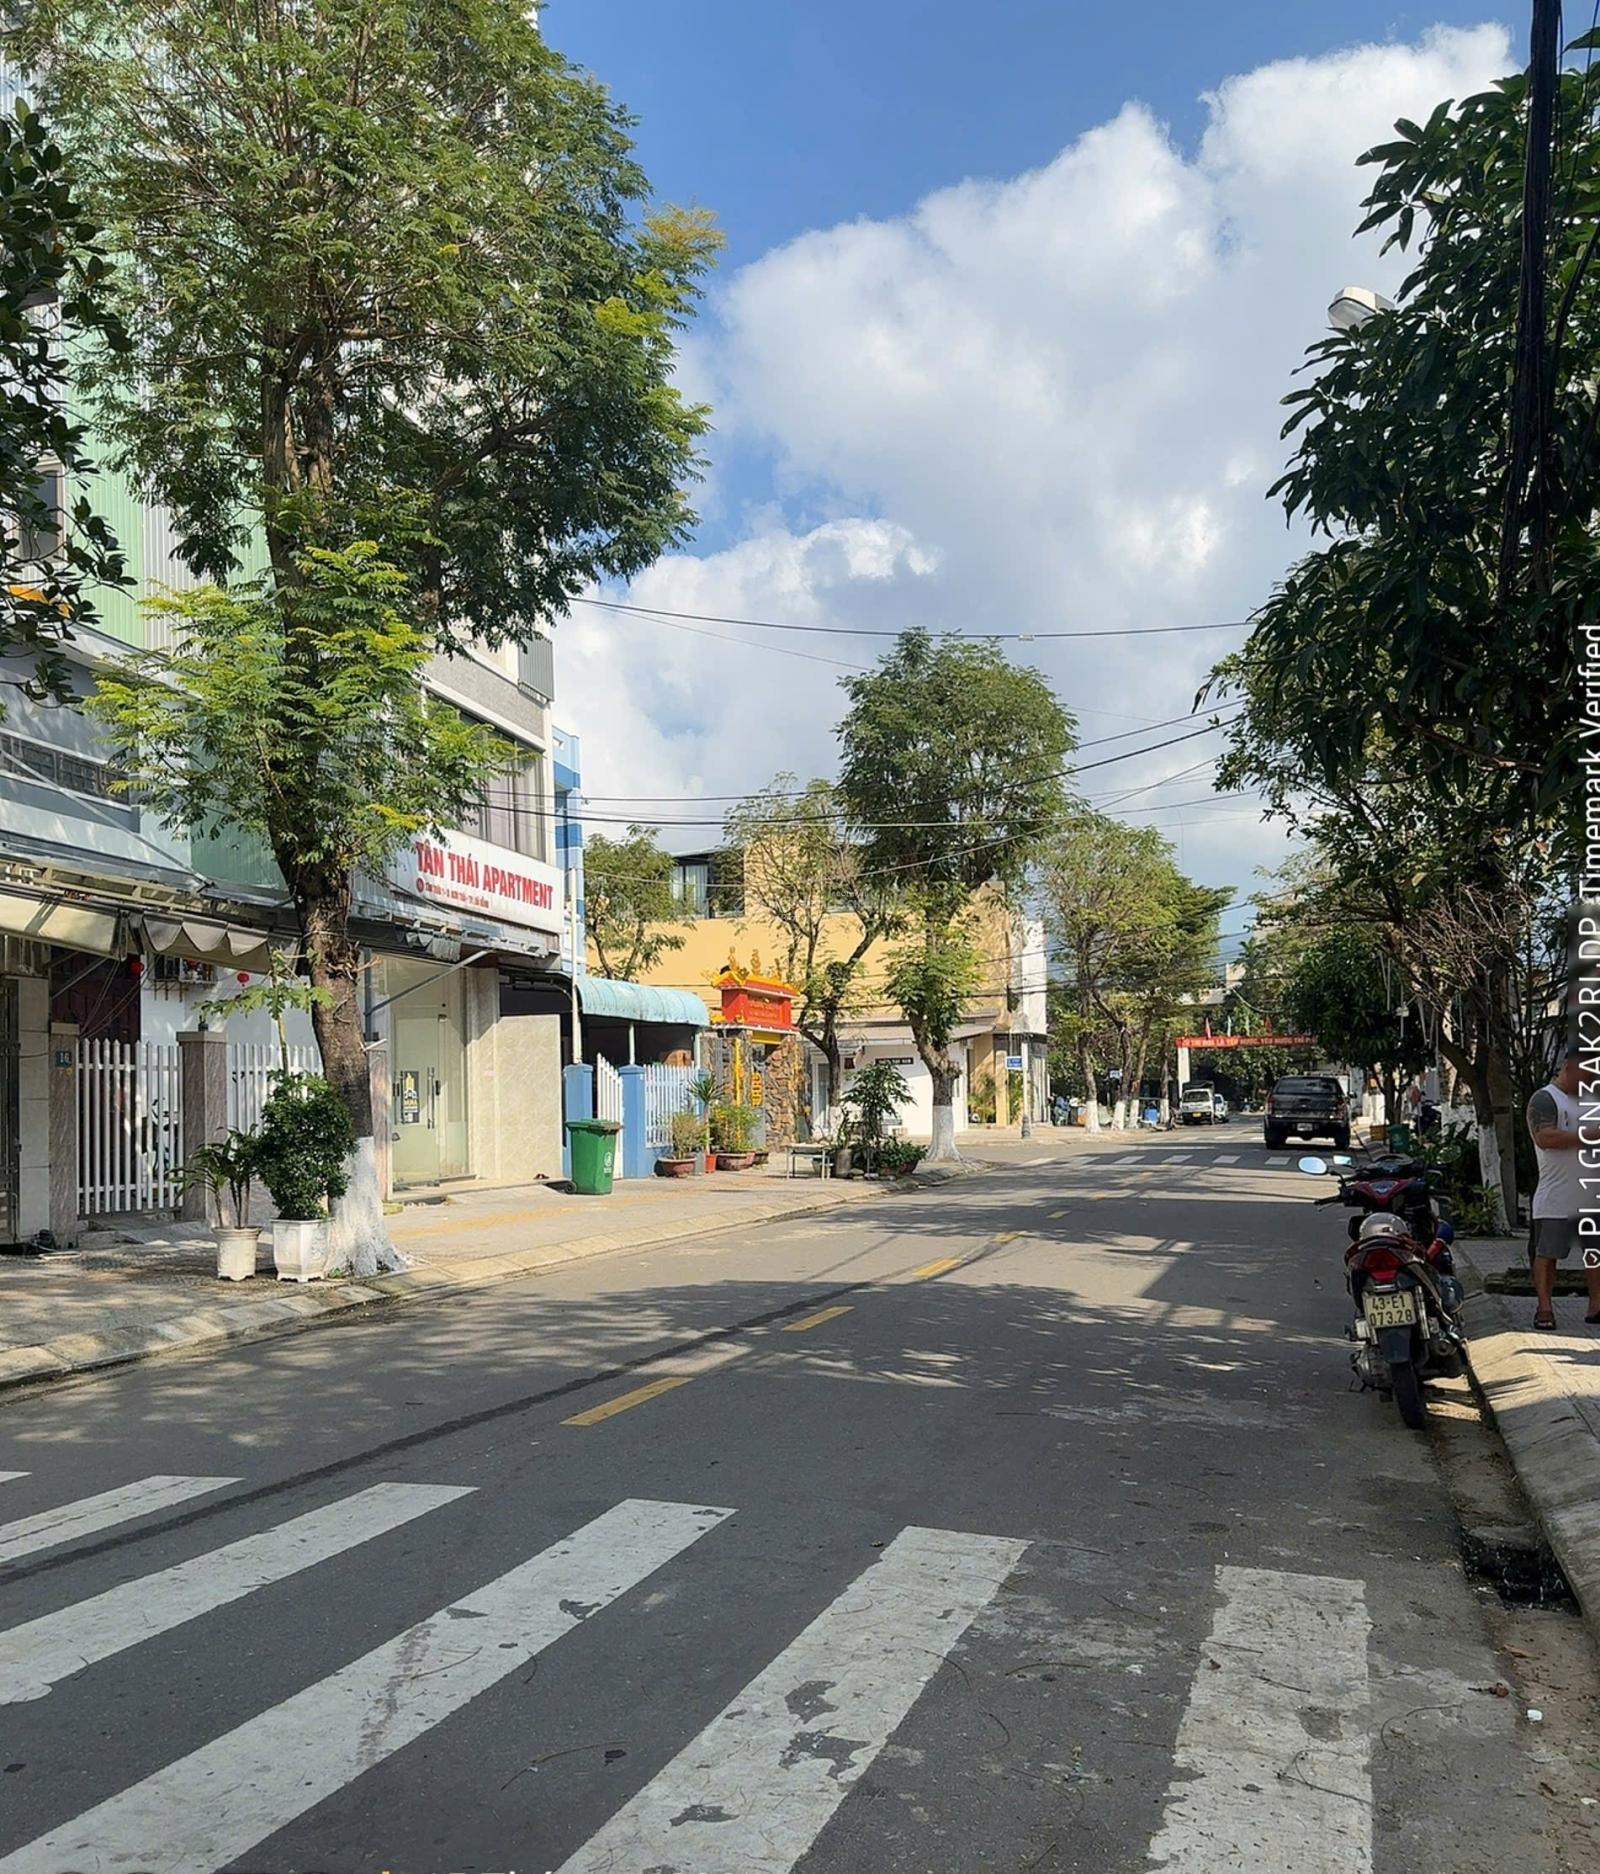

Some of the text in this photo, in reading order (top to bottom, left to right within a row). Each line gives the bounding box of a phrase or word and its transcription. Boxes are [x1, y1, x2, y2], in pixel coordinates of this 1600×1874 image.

[415, 838, 444, 878] TÂN
[448, 853, 479, 889] THÁI
[483, 864, 553, 910] APARTMENT
[1372, 1295, 1405, 1310] 43-E1
[1369, 1308, 1412, 1327] 073.28
